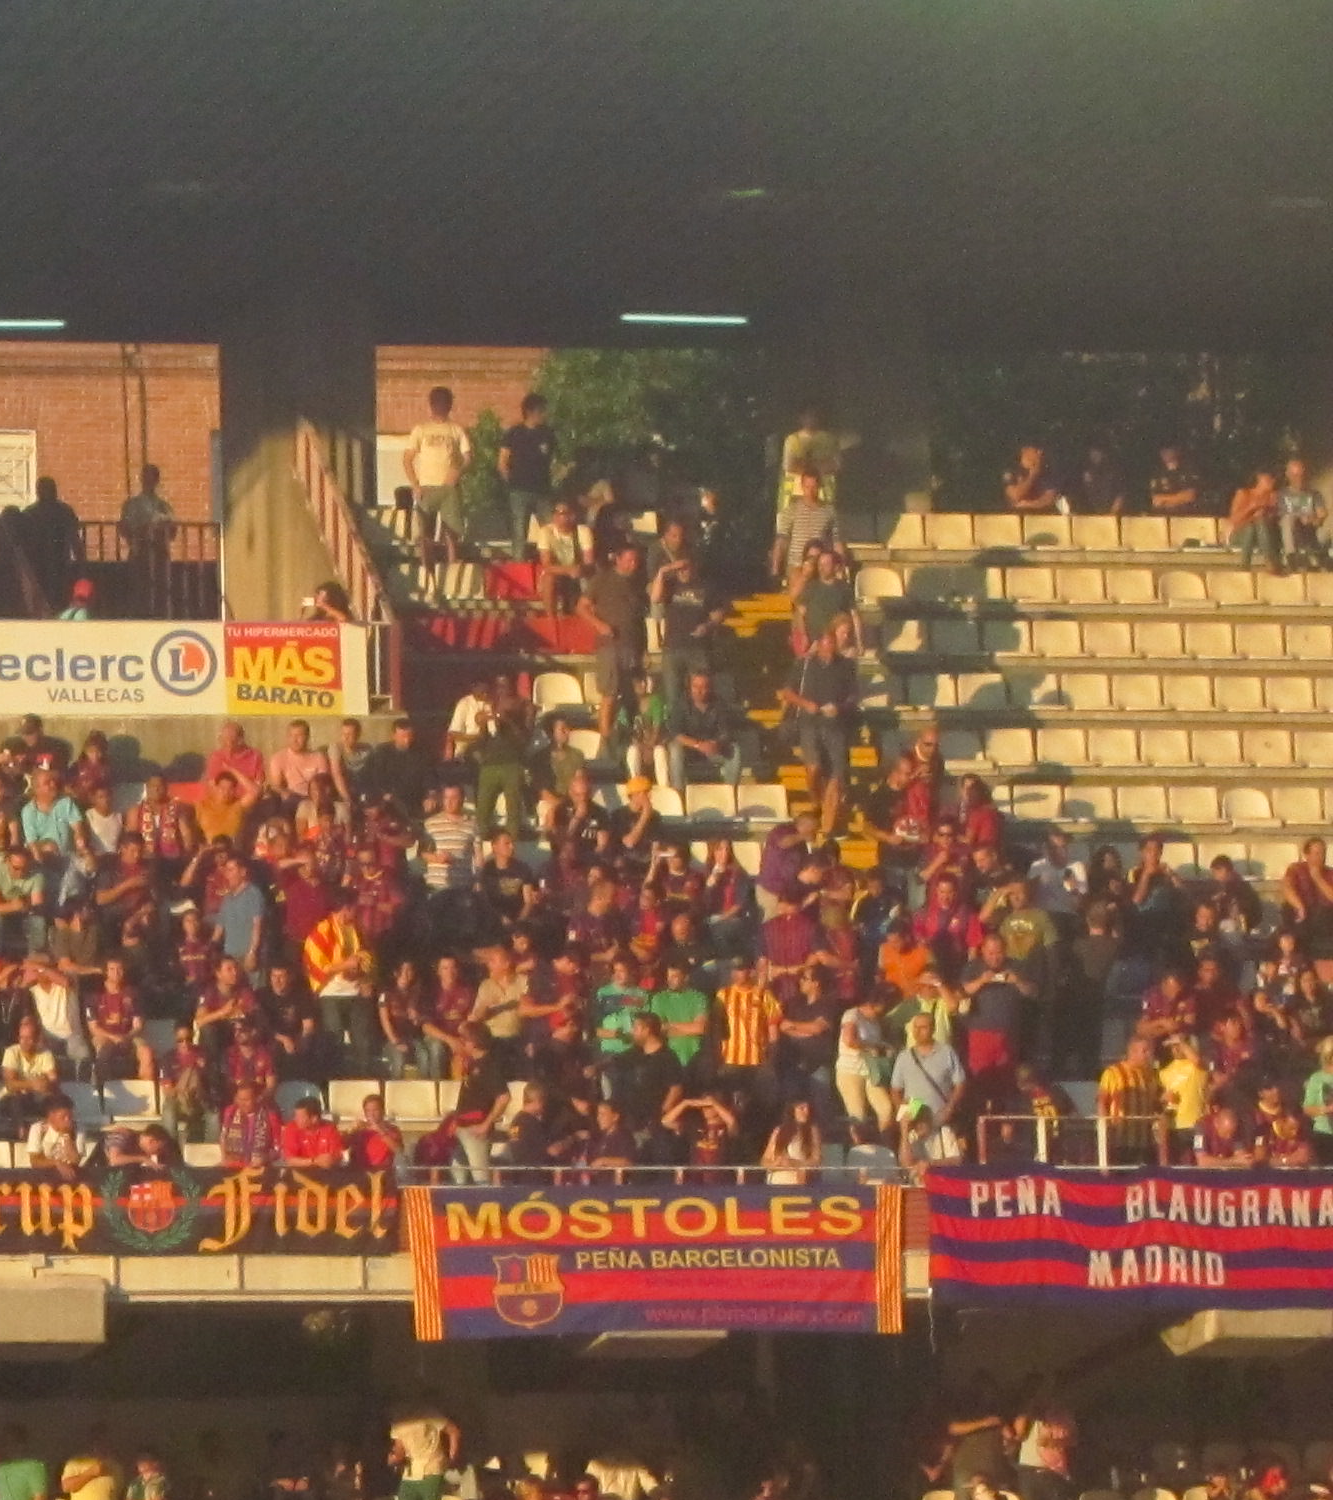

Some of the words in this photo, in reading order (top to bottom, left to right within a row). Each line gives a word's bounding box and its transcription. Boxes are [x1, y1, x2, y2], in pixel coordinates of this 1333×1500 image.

[227, 627, 240, 637] TU
[244, 626, 337, 637] HIPERMERCADO
[233, 642, 335, 684] MÁS
[47, 687, 144, 703] VALLECAS
[237, 683, 334, 707] BARATO
[199, 1166, 388, 1253] Fidel
[445, 1191, 864, 1240] MÓSTOLES
[970, 1175, 1062, 1217] PEÑA
[576, 1249, 644, 1270] PEÑA
[651, 1247, 840, 1269] BARCELONISTA
[1087, 1244, 1225, 1288] MADRID
